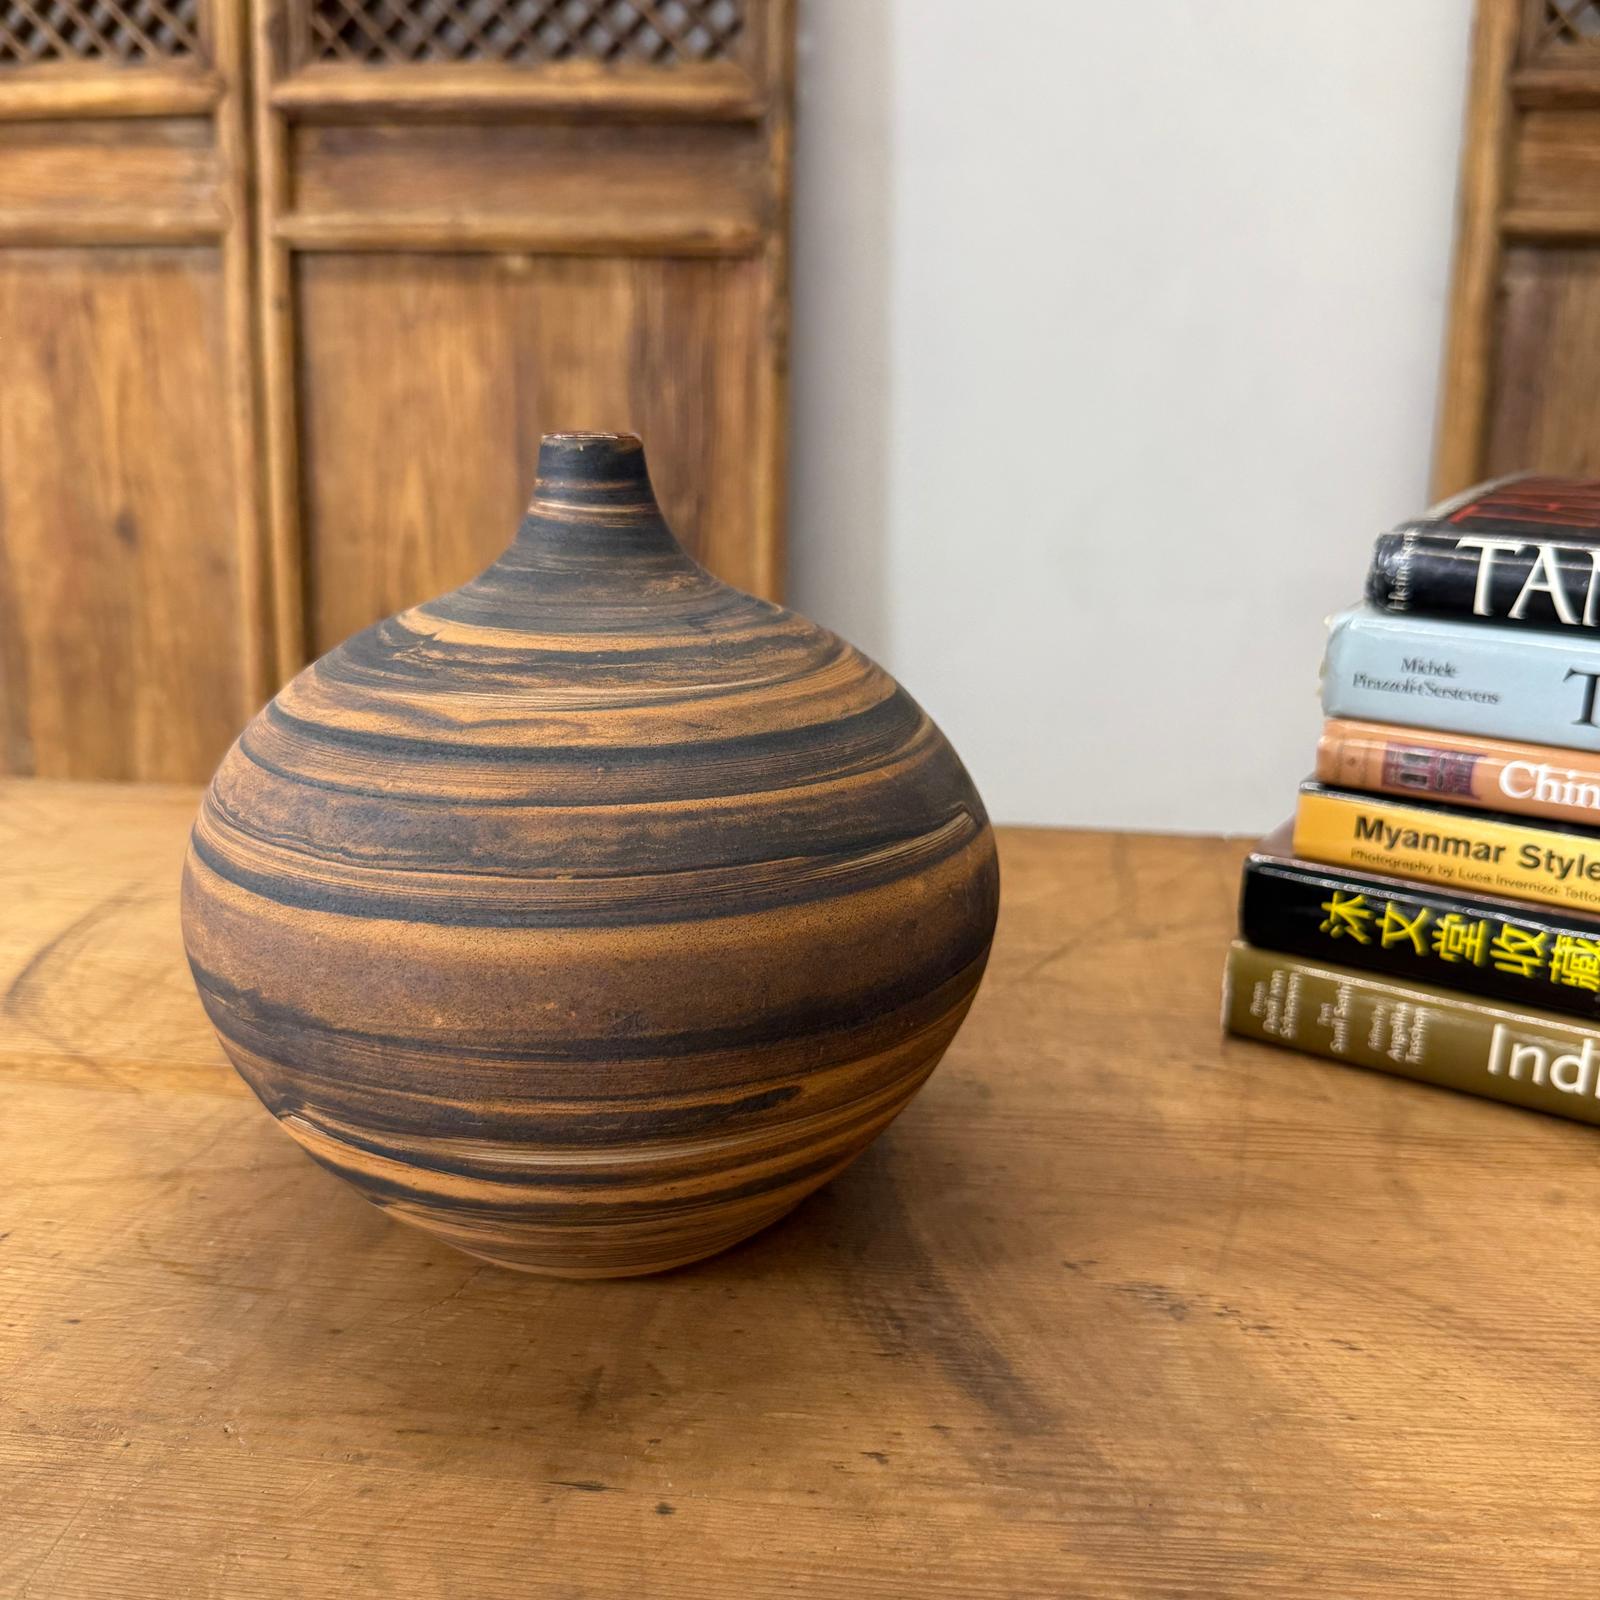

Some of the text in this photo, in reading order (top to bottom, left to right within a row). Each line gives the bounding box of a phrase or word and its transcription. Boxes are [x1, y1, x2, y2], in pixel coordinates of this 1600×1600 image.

[1401, 657, 1458, 678] Michele
[1499, 760, 1600, 810] Chin
[1351, 848, 1433, 874] Photography
[1438, 863, 1454, 877] by
[1354, 815, 1600, 880] Myanmar Style
[1319, 890, 1600, 993] 沐文堂收藏
